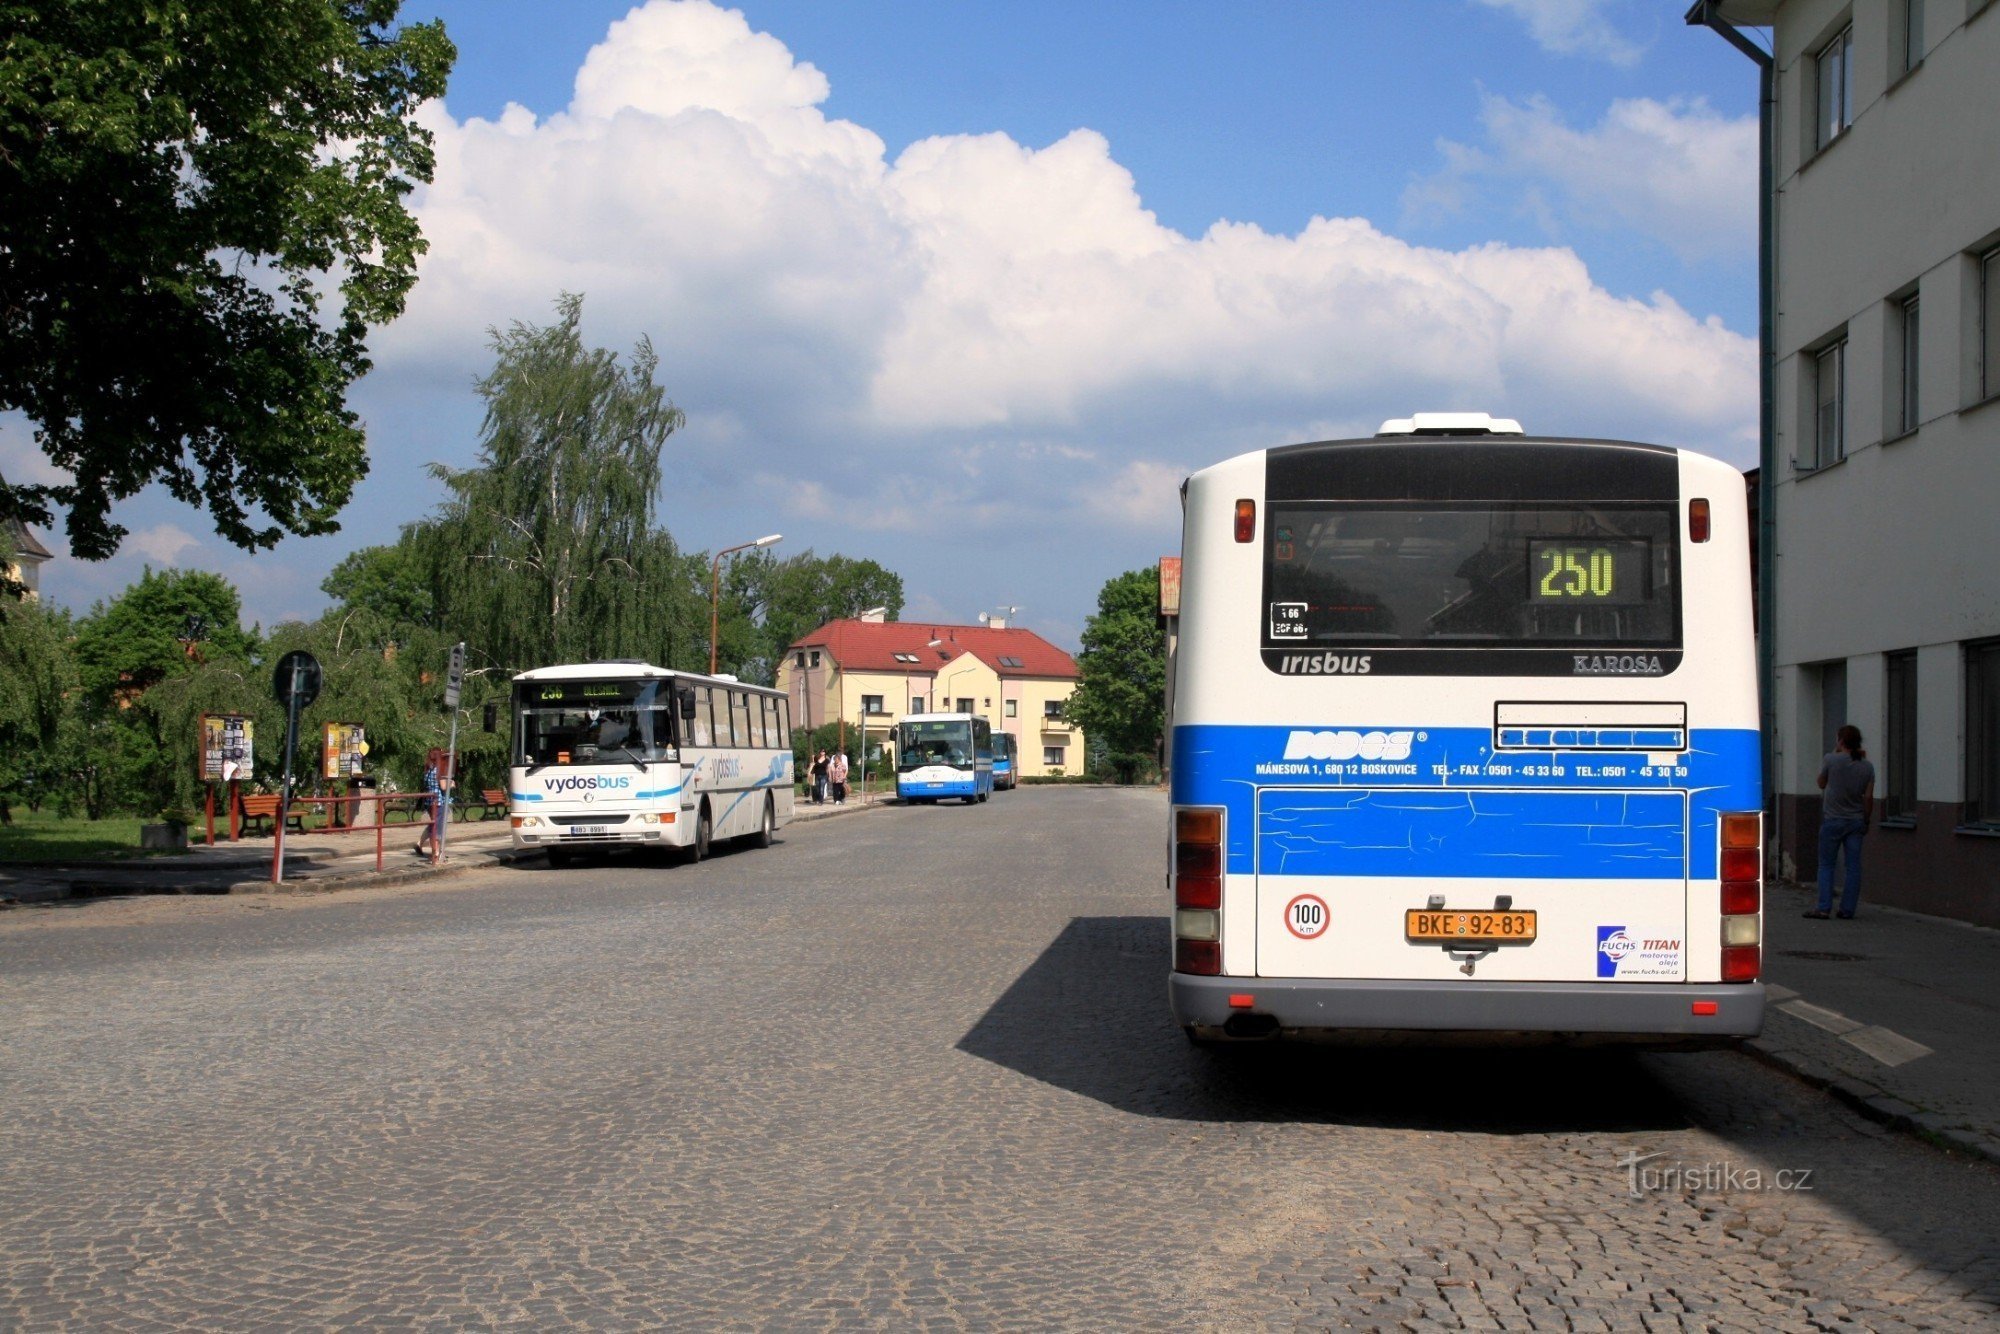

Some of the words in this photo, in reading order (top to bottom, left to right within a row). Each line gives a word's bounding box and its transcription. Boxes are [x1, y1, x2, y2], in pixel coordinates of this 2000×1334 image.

[1541, 547, 1612, 596] 250
[1281, 652, 1372, 674] irisbus
[1573, 655, 1664, 674] KAROSA
[1256, 761, 1310, 775] MÁNESOVA
[1312, 764, 1322, 776] 1,
[1325, 764, 1343, 775] 680
[1346, 764, 1358, 775] 12
[1361, 764, 1417, 775] BOSKOVICE
[1460, 764, 1480, 776] FAX
[1522, 765, 1535, 776] 45
[1537, 765, 1550, 776] 33
[1552, 765, 1565, 776] 60
[1602, 766, 1626, 777] 0501
[1639, 766, 1652, 777] 45
[1657, 766, 1670, 777] 30
[1675, 766, 1688, 777] 50
[545, 775, 629, 793] vydosbus
[1294, 904, 1321, 924] 100
[1299, 925, 1315, 933] km
[1418, 915, 1454, 935] BKE
[1470, 915, 1526, 935] 92-83
[1601, 942, 1636, 950] FUCHS
[1643, 939, 1681, 951] TITAN
